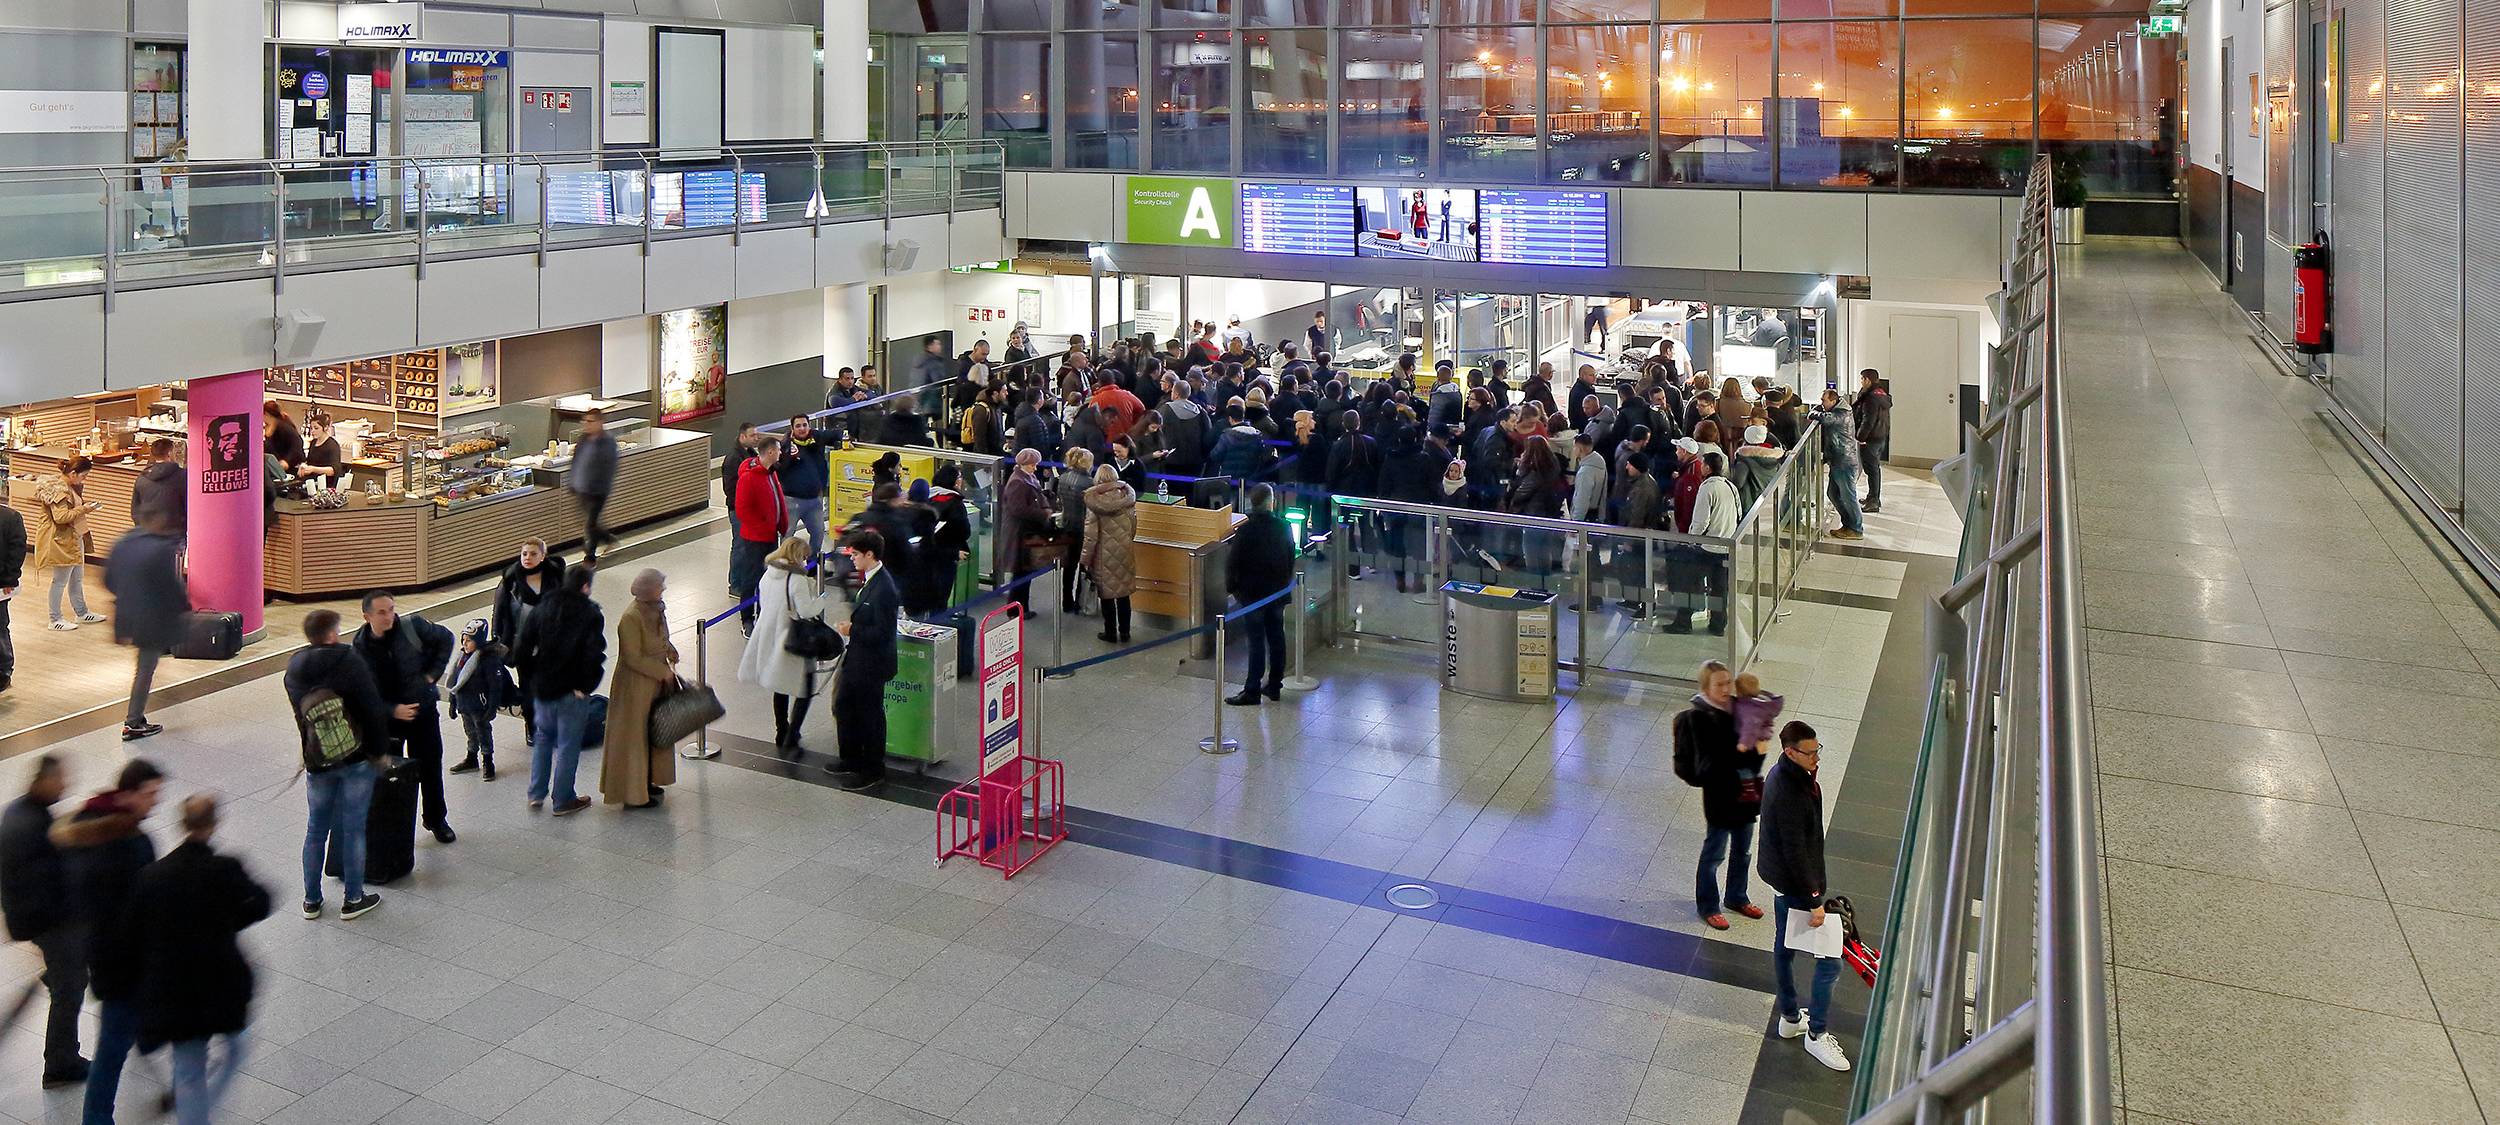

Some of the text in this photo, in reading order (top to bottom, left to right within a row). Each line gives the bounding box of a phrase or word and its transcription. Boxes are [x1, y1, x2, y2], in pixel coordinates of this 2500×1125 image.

[346, 23, 412, 38] HOLIMAXX
[410, 50, 500, 67] HOLIMAXX
[29, 102, 74, 113] Gut geht's
[1134, 189, 1180, 199] Kontrollstelle
[1180, 186, 1221, 239] A
[203, 468, 248, 483] COFFEE
[203, 480, 248, 492] FELLOWS
[1446, 625, 1457, 678] waste
[883, 693, 907, 703] uropa
